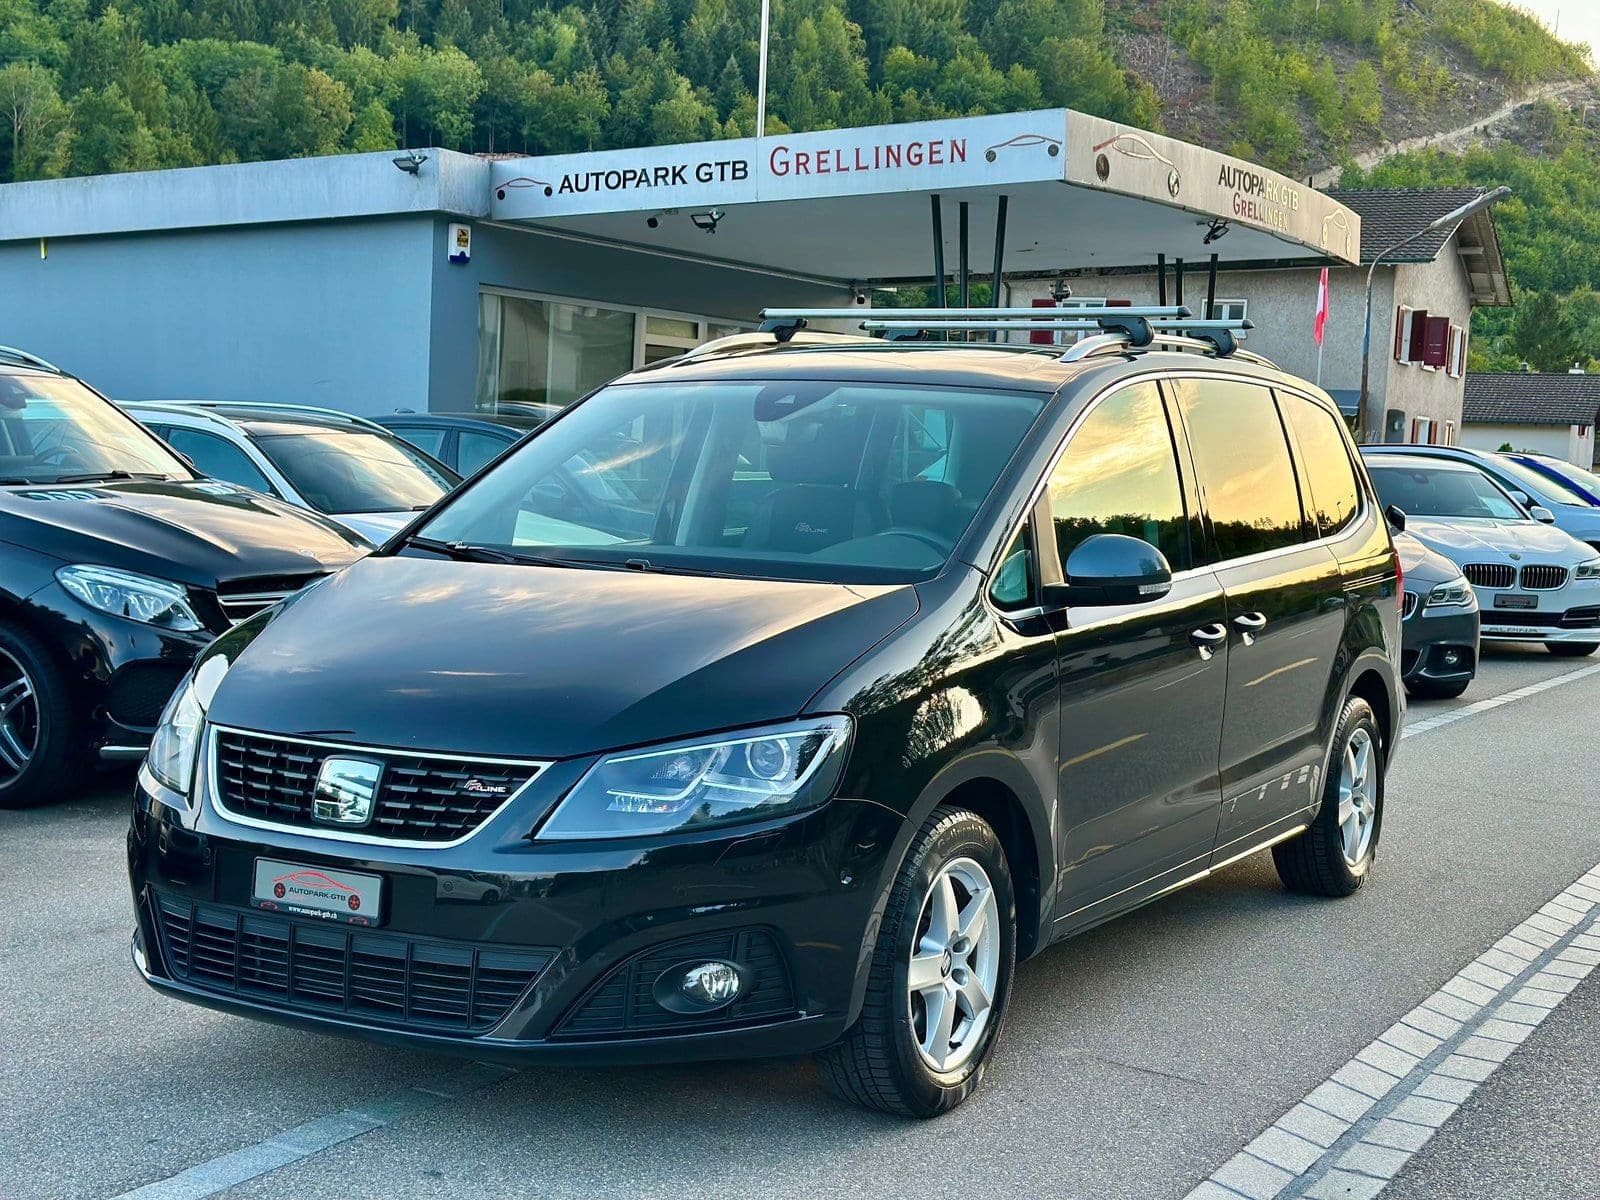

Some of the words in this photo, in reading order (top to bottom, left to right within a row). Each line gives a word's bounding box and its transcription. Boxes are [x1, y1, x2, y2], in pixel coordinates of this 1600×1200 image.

[557, 164, 689, 195] AUTOPARK
[694, 159, 749, 184] GTB
[769, 138, 967, 177] GRELLINGEN
[1218, 163, 1279, 203] AUTOPARK
[1281, 186, 1299, 212] GTB
[1233, 192, 1288, 232] GRELLINGEN
[288, 886, 346, 902] AUTOPARK-GTB
